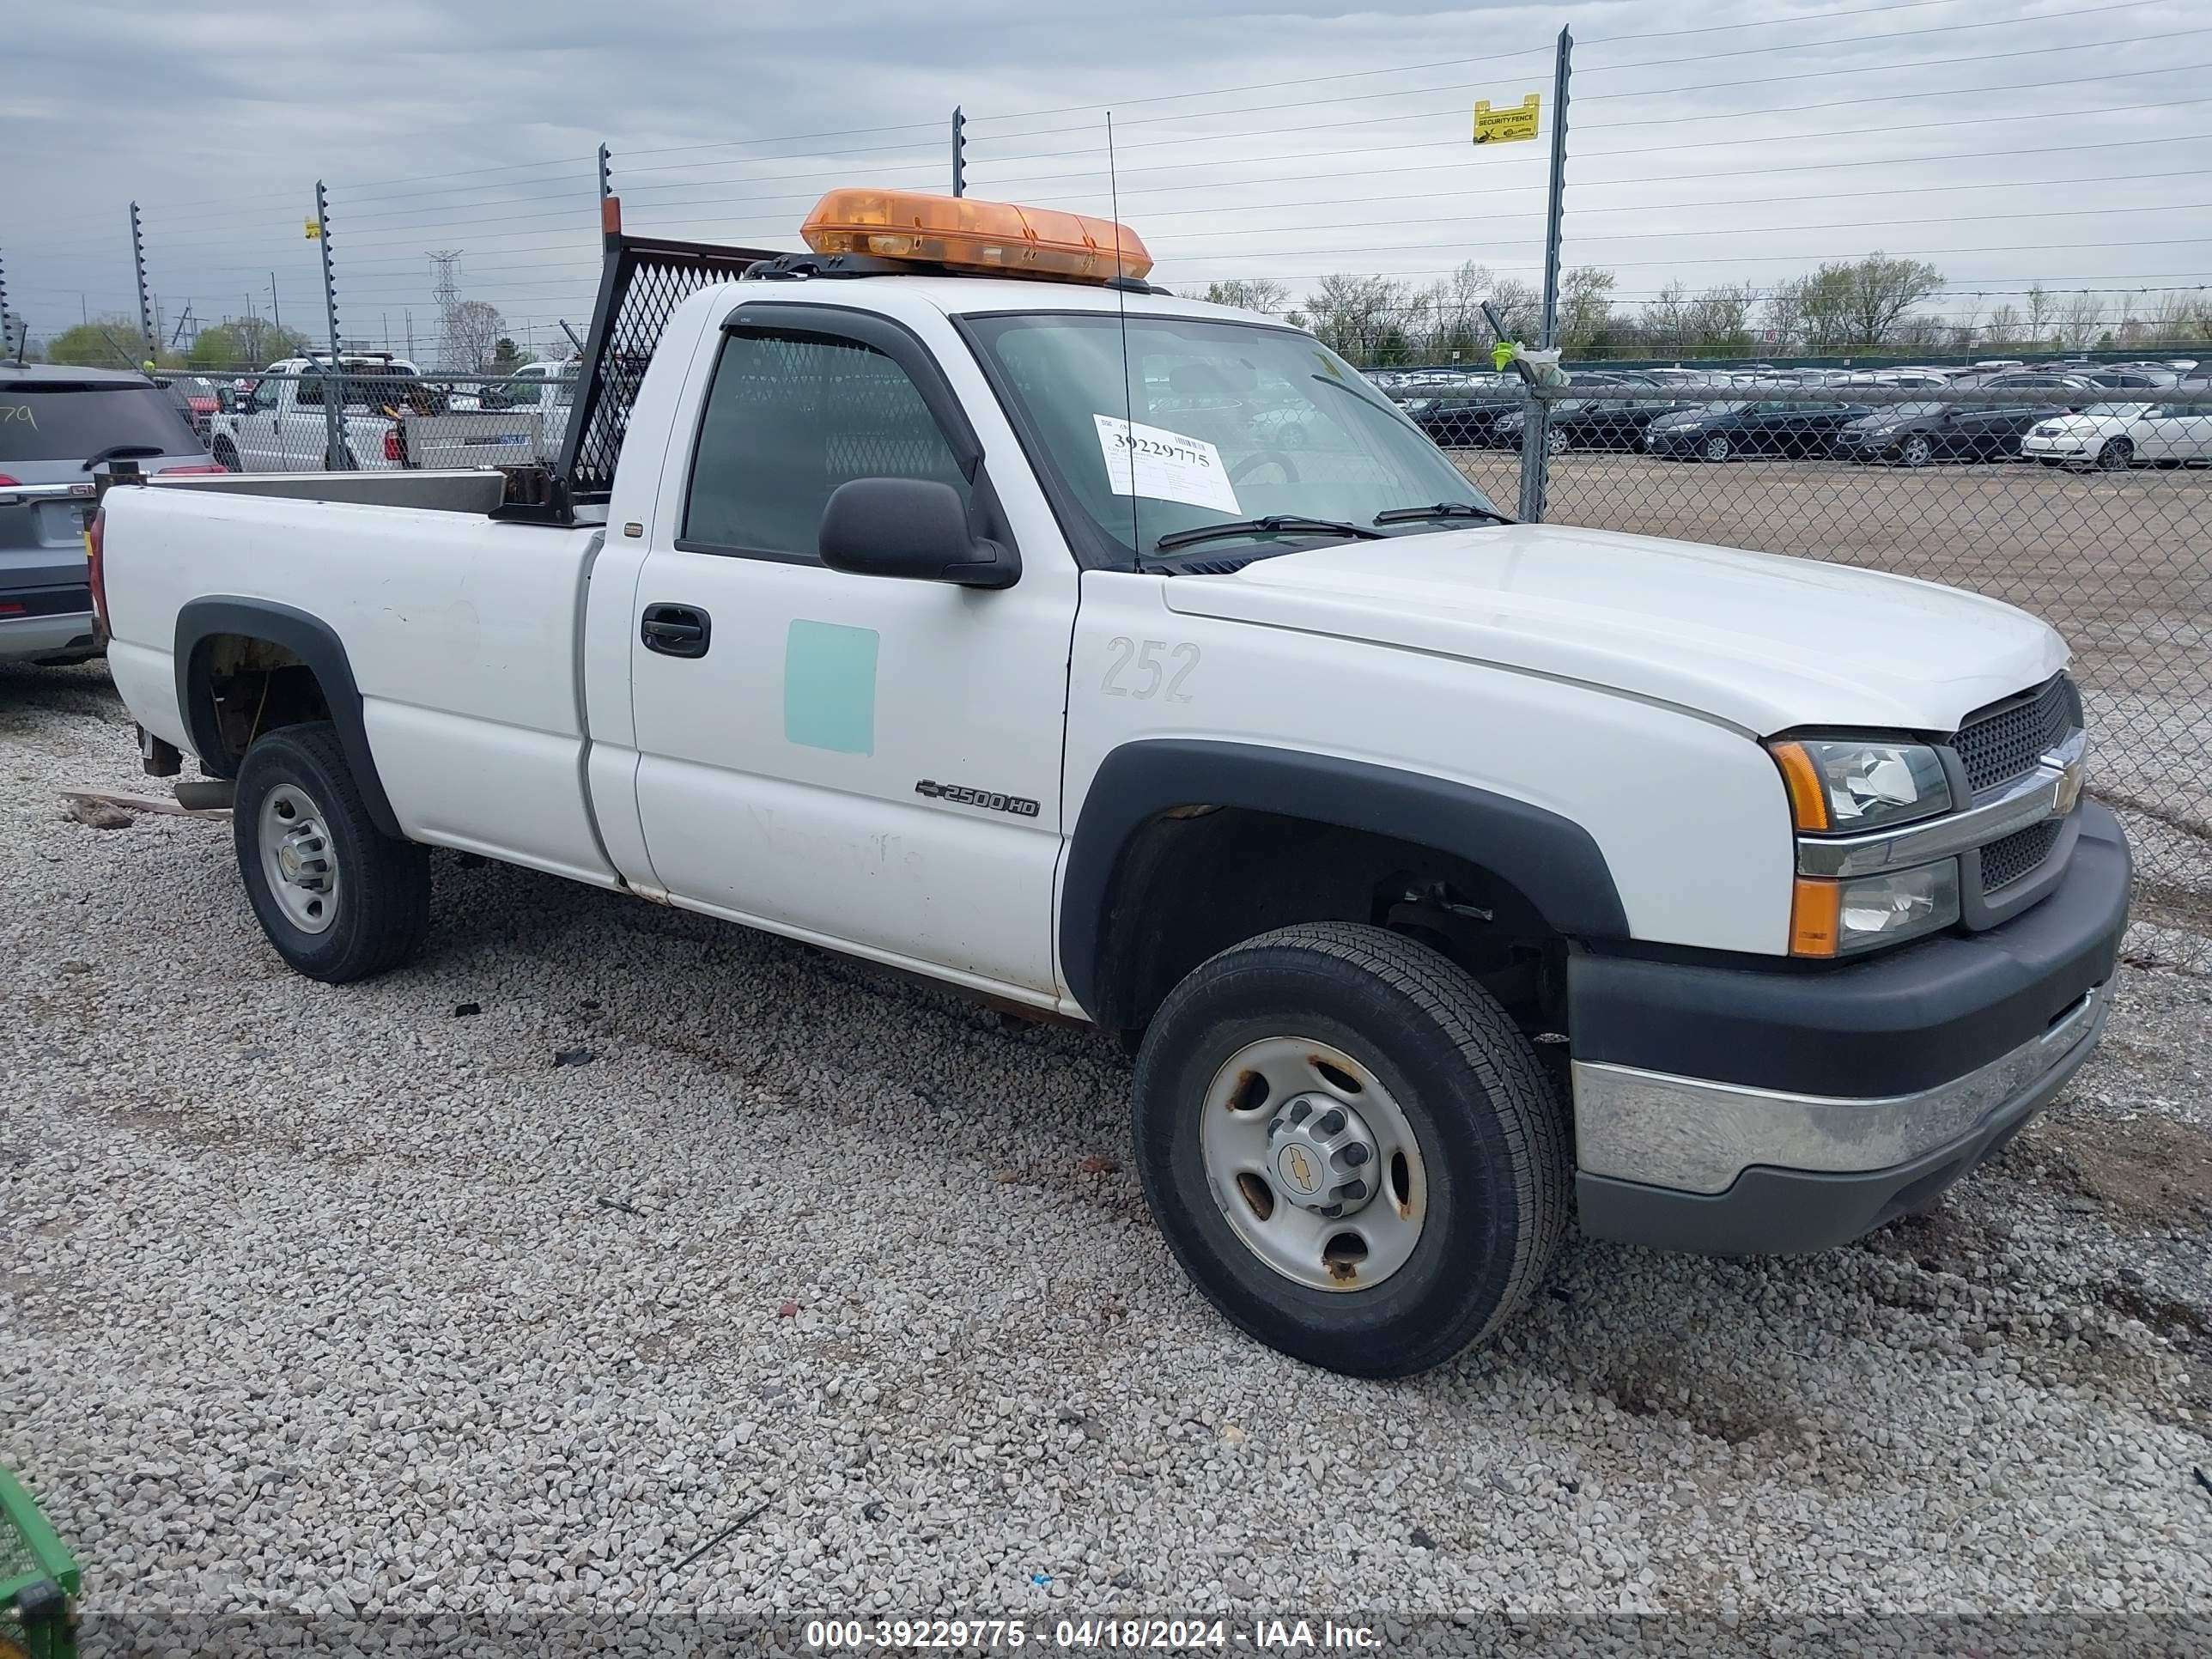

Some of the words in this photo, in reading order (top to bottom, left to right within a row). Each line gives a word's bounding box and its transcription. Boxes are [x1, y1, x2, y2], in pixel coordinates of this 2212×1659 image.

[1479, 117, 1511, 126] SECURITY
[1512, 113, 1534, 123] FENCE
[1113, 434, 1210, 468] 39229775
[1101, 636, 1200, 703] 252
[945, 786, 1006, 810] 2500
